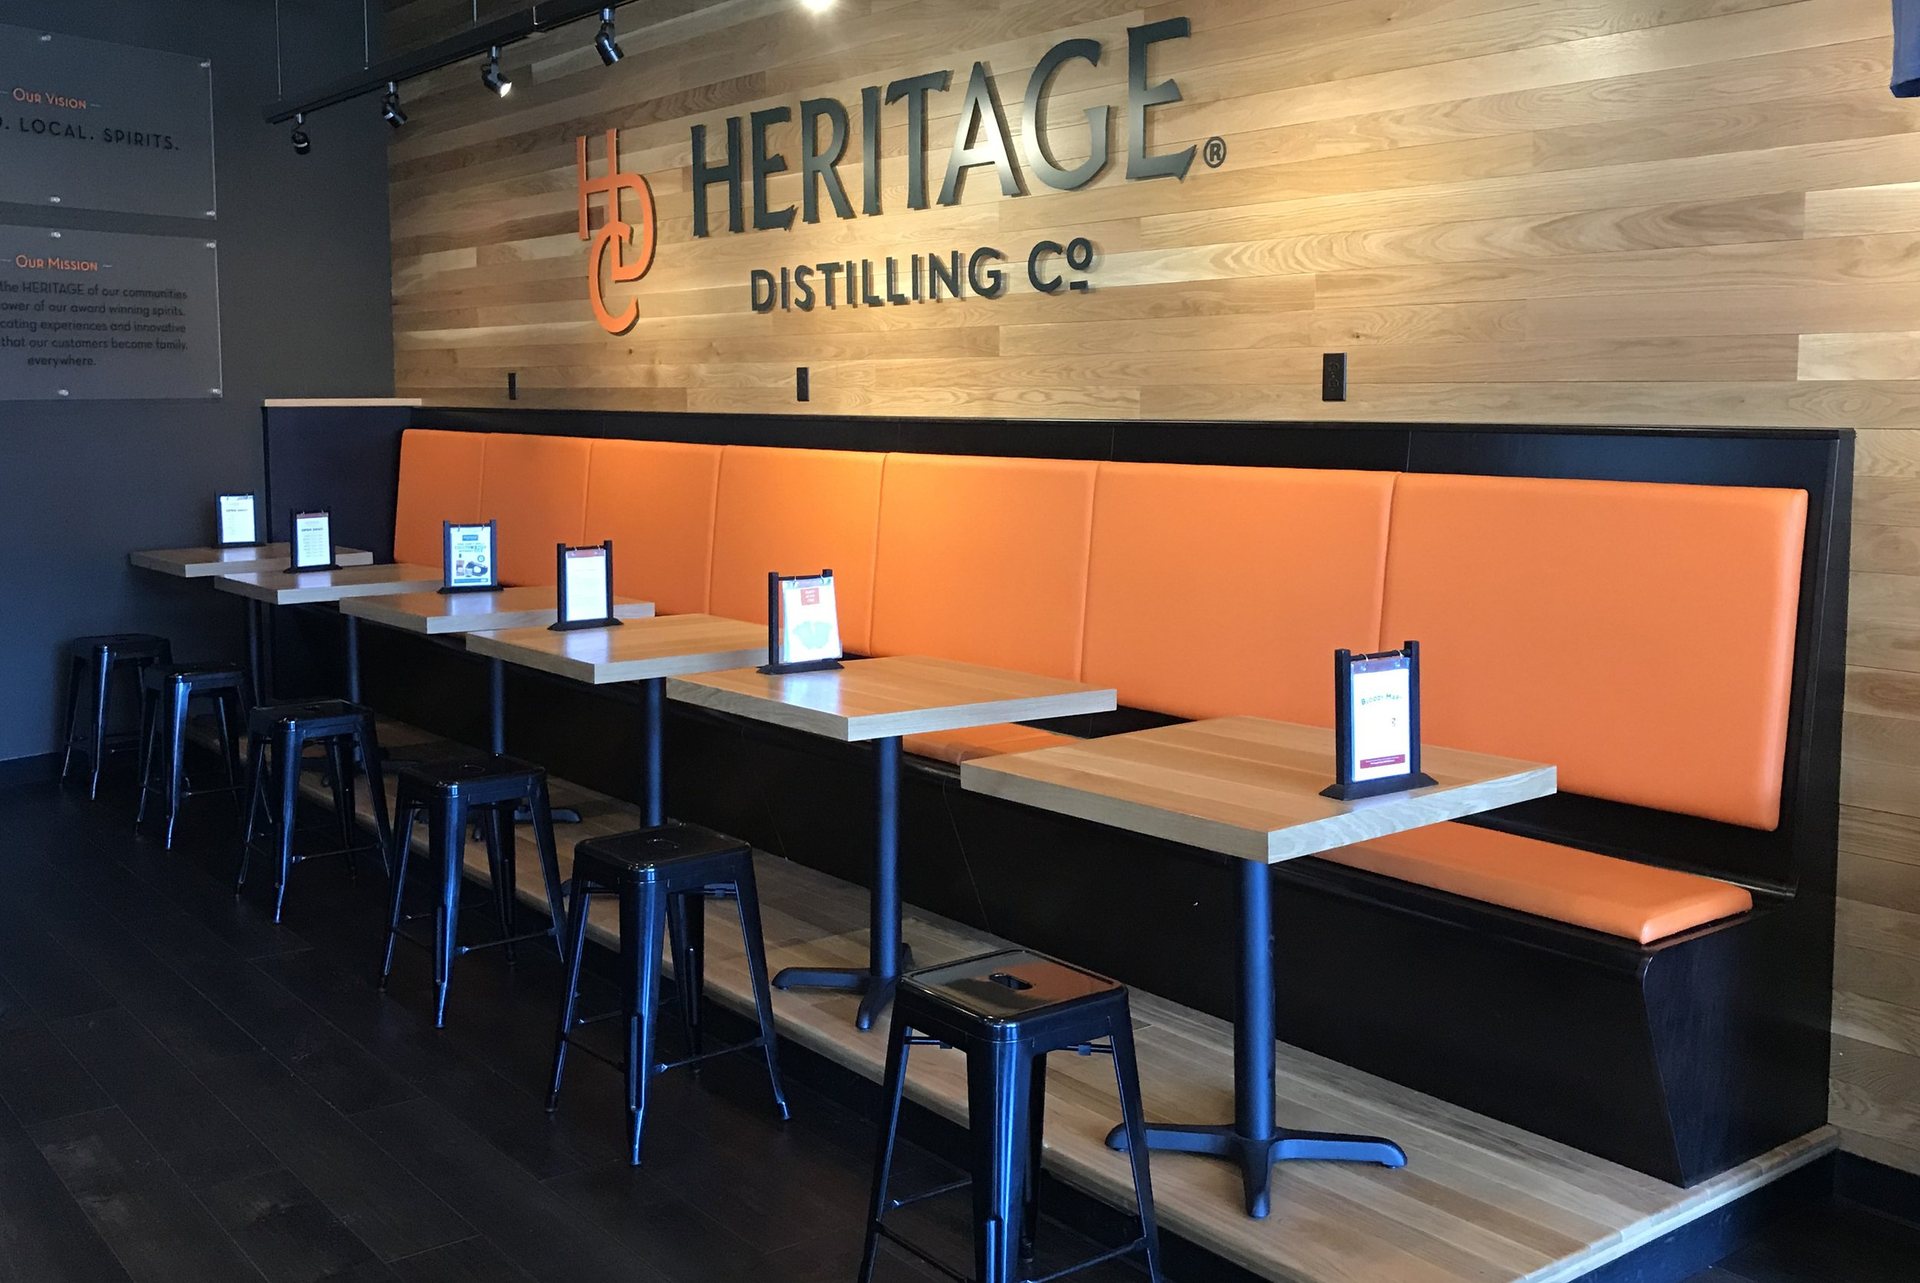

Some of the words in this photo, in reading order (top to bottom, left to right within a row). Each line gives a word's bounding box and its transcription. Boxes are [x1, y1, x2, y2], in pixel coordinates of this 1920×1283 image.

[19, 117, 94, 141] LOCAL.
[103, 128, 180, 151] SPIRITS.
[691, 16, 1197, 238] HERITAGE
[752, 246, 1004, 313] DISTILLING
[22, 281, 84, 296] HERITAGE
[88, 284, 99, 297] of
[102, 288, 119, 298] our
[123, 288, 188, 300] communities
[34, 299, 45, 312] of
[48, 303, 67, 313] our
[70, 303, 106, 314] award
[109, 304, 150, 318] winning
[40, 321, 108, 333] experiences
[110, 321, 131, 332] and
[134, 321, 187, 334] innovative
[1, 335, 26, 348] that
[29, 339, 48, 349] our
[51, 337, 108, 350] customers
[111, 337, 153, 350] become
[27, 354, 97, 368] everywhere.
